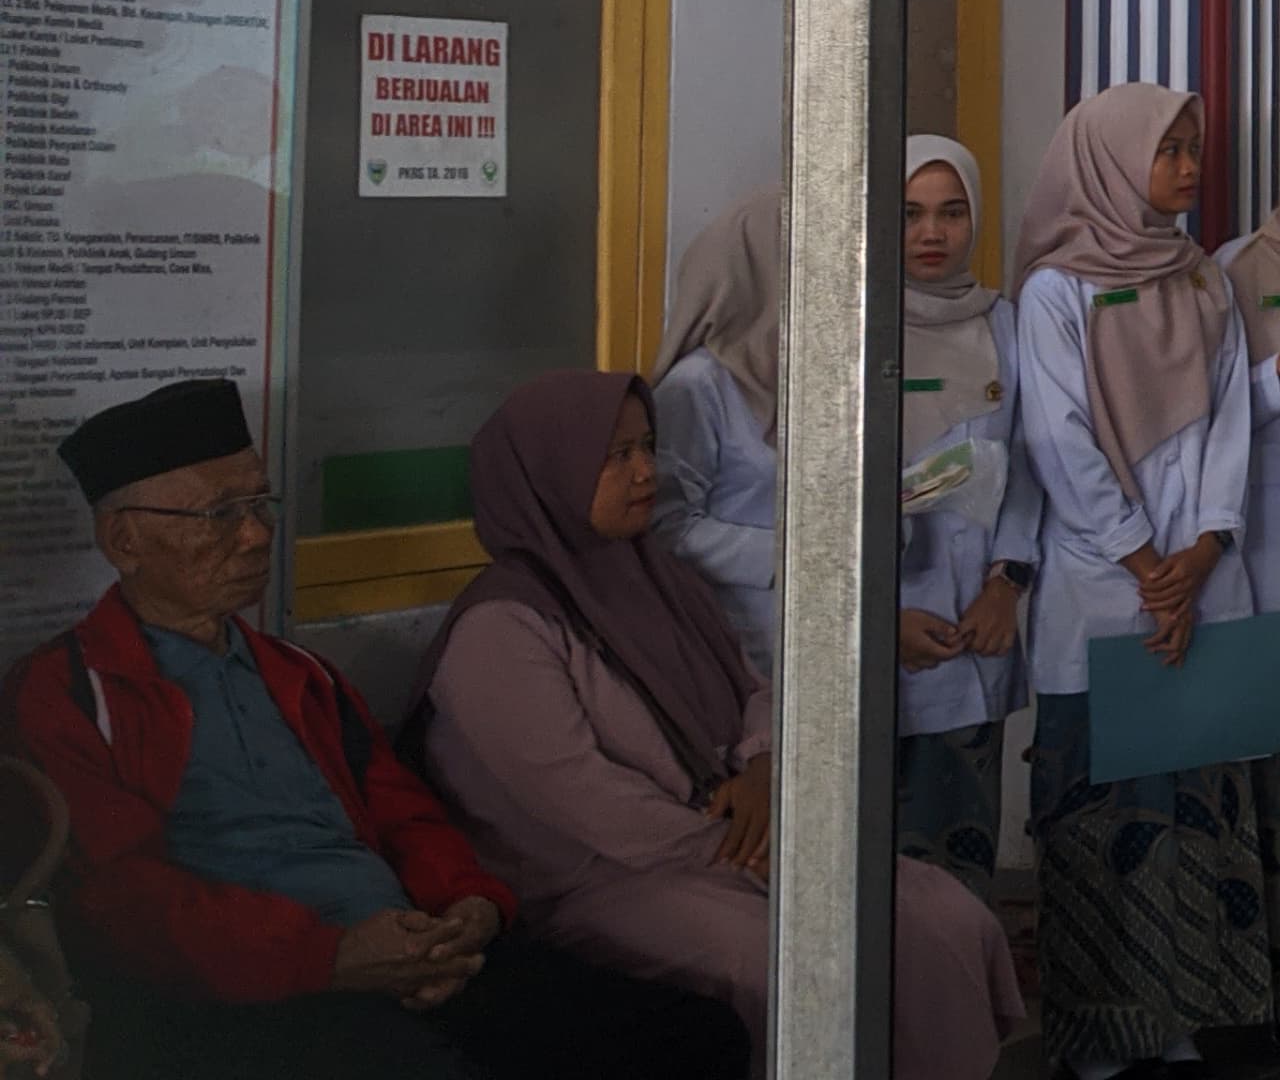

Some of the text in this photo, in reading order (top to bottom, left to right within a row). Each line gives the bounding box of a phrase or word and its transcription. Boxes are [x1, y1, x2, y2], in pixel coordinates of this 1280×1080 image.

[367, 32, 501, 67] DI LARANG
[376, 76, 490, 103] BERJUALAN
[371, 112, 496, 139] DI AREA INI !!!
